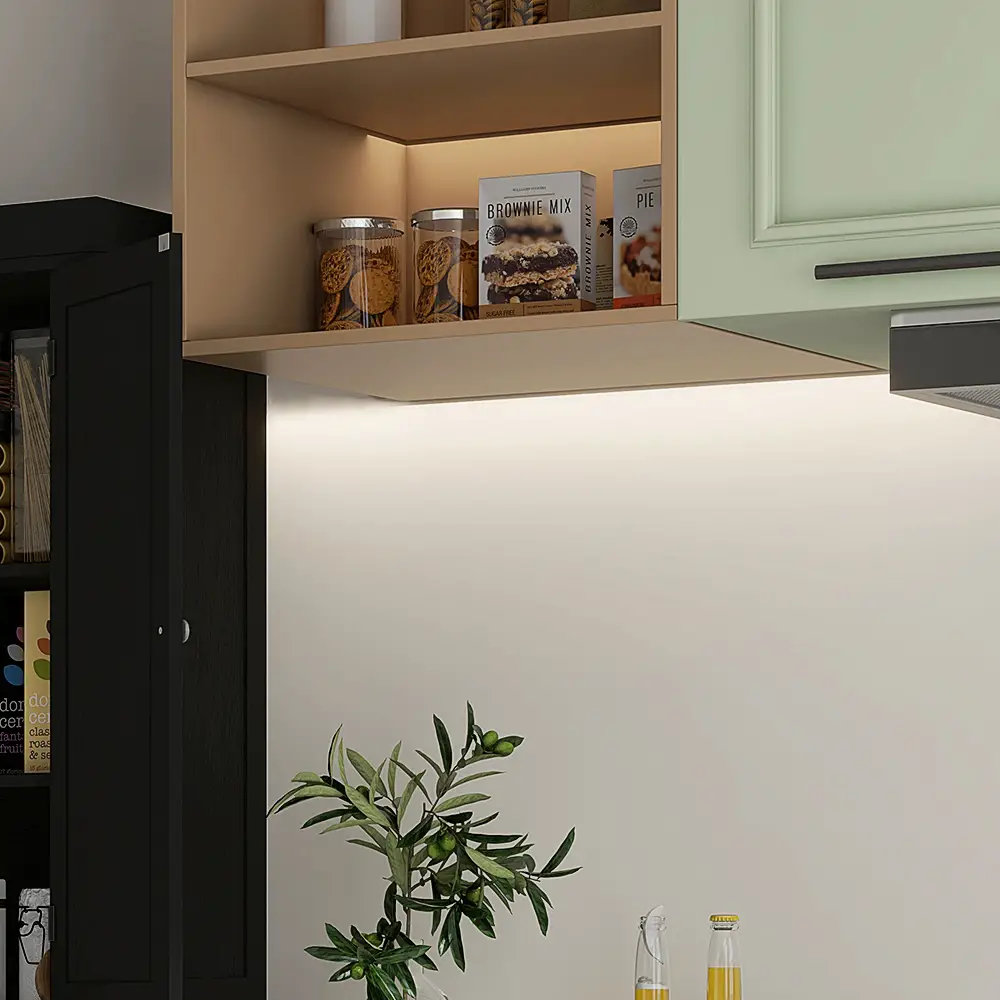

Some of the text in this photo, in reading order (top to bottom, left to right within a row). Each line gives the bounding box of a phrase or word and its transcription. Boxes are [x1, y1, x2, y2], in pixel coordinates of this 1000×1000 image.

[487, 197, 572, 219] BROWNIE MIX
[637, 192, 654, 209] PIE
[29, 750, 38, 760] &
